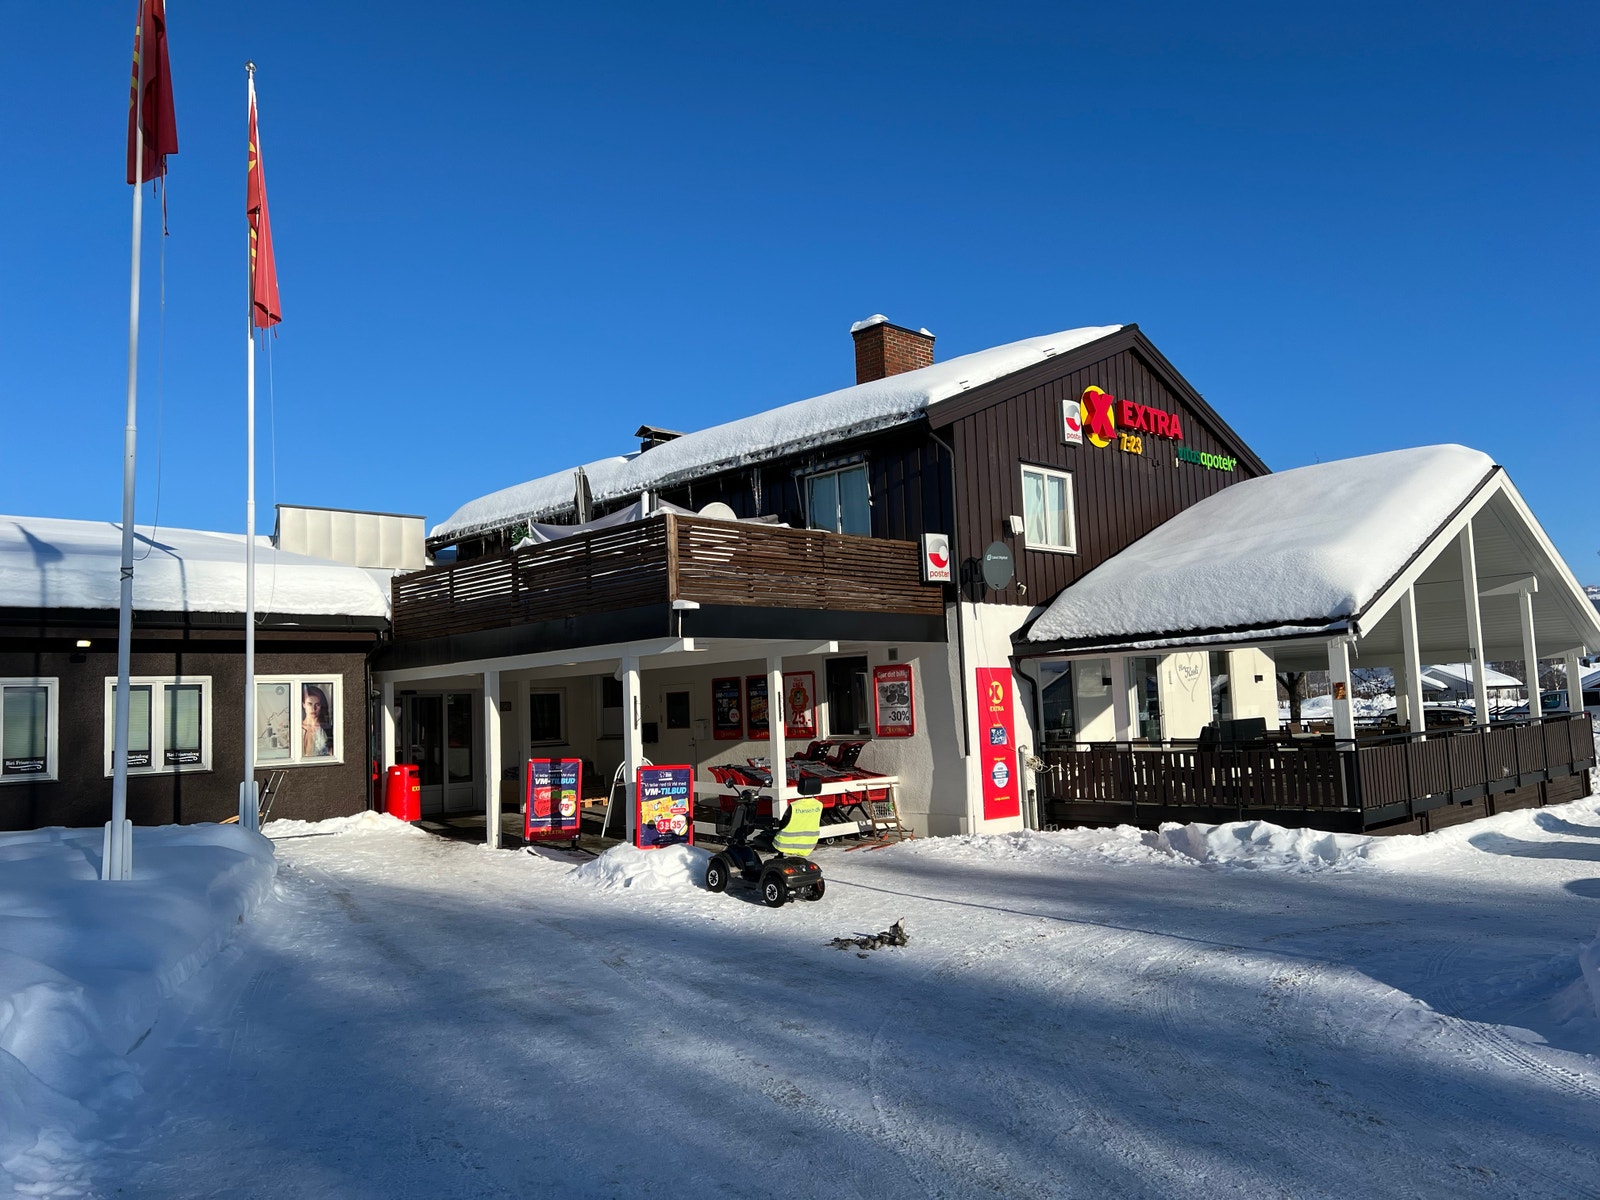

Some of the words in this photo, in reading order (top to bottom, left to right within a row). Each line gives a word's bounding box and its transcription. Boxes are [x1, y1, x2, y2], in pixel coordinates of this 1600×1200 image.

[1117, 400, 1183, 440] EXTRA
[888, 711, 910, 721] -30%
[535, 777, 576, 785] VM-TILBUD
[644, 787, 687, 796] VM-TILBUD
